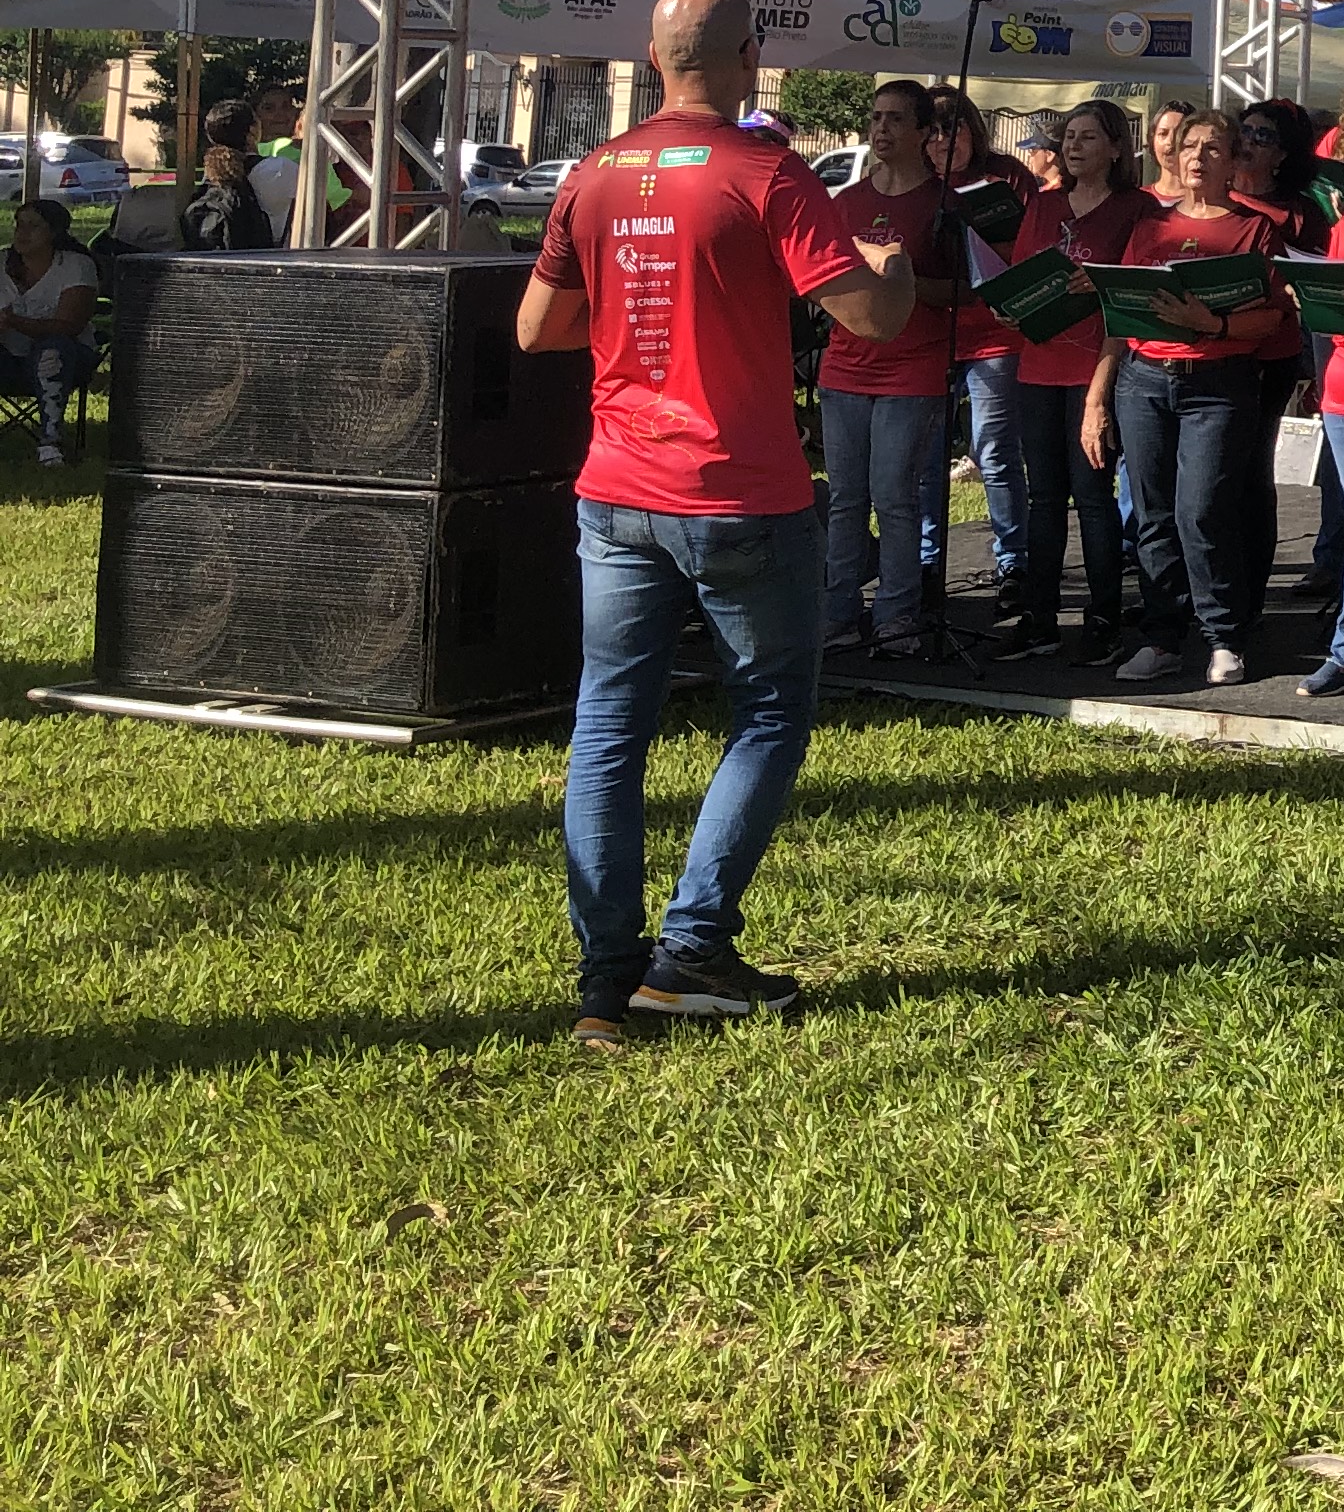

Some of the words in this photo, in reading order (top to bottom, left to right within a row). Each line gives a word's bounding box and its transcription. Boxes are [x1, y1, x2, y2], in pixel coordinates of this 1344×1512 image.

[755, 8, 810, 29] MED
[1024, 13, 1062, 26] Point
[1152, 40, 1188, 54] VISUAL
[613, 218, 629, 237] LA
[631, 216, 675, 236] MAGLIA
[639, 261, 677, 273] Impper
[637, 296, 673, 307] CRESOL
